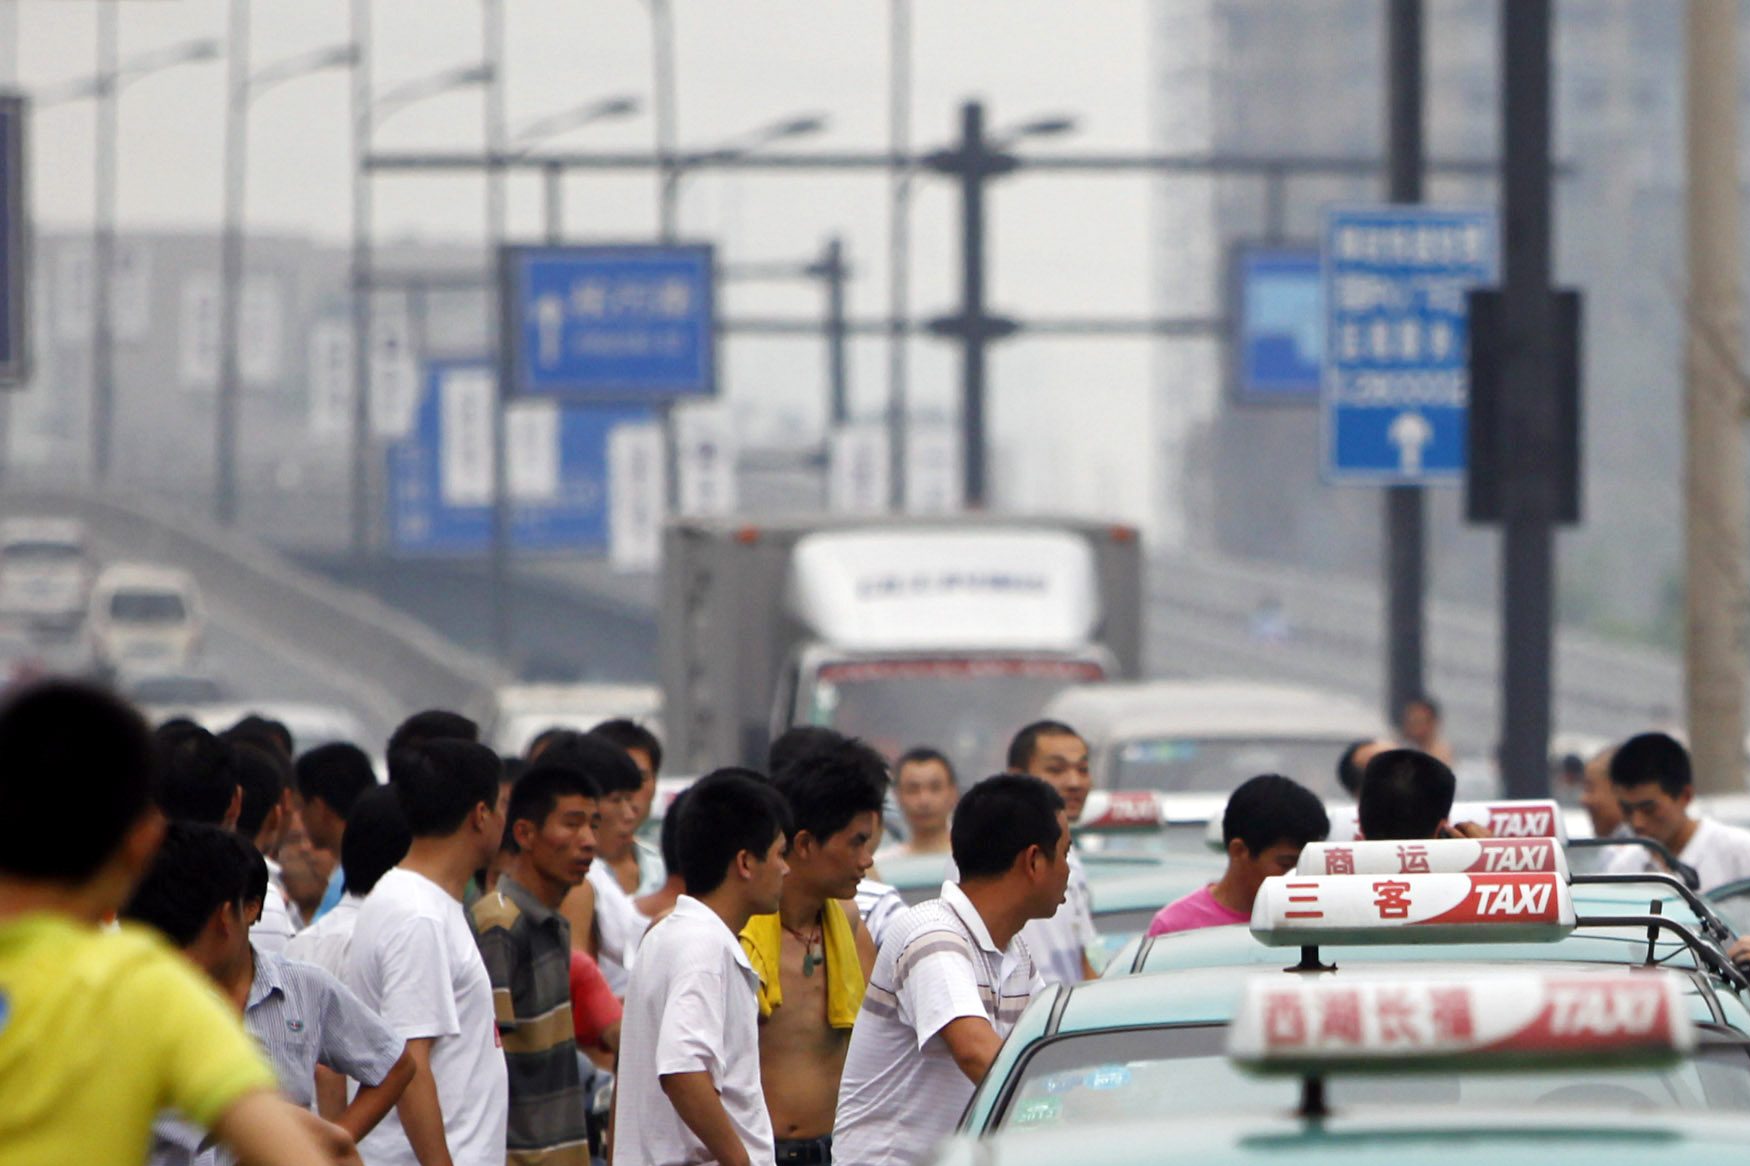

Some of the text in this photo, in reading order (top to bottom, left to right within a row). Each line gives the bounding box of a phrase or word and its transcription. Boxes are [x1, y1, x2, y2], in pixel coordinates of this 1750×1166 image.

[1491, 812, 1550, 837] TAXI
[1324, 845, 1549, 874] 商运 TAXI
[1284, 880, 1552, 919] 三客 TAXI
[1549, 988, 1661, 1037] TAXI
